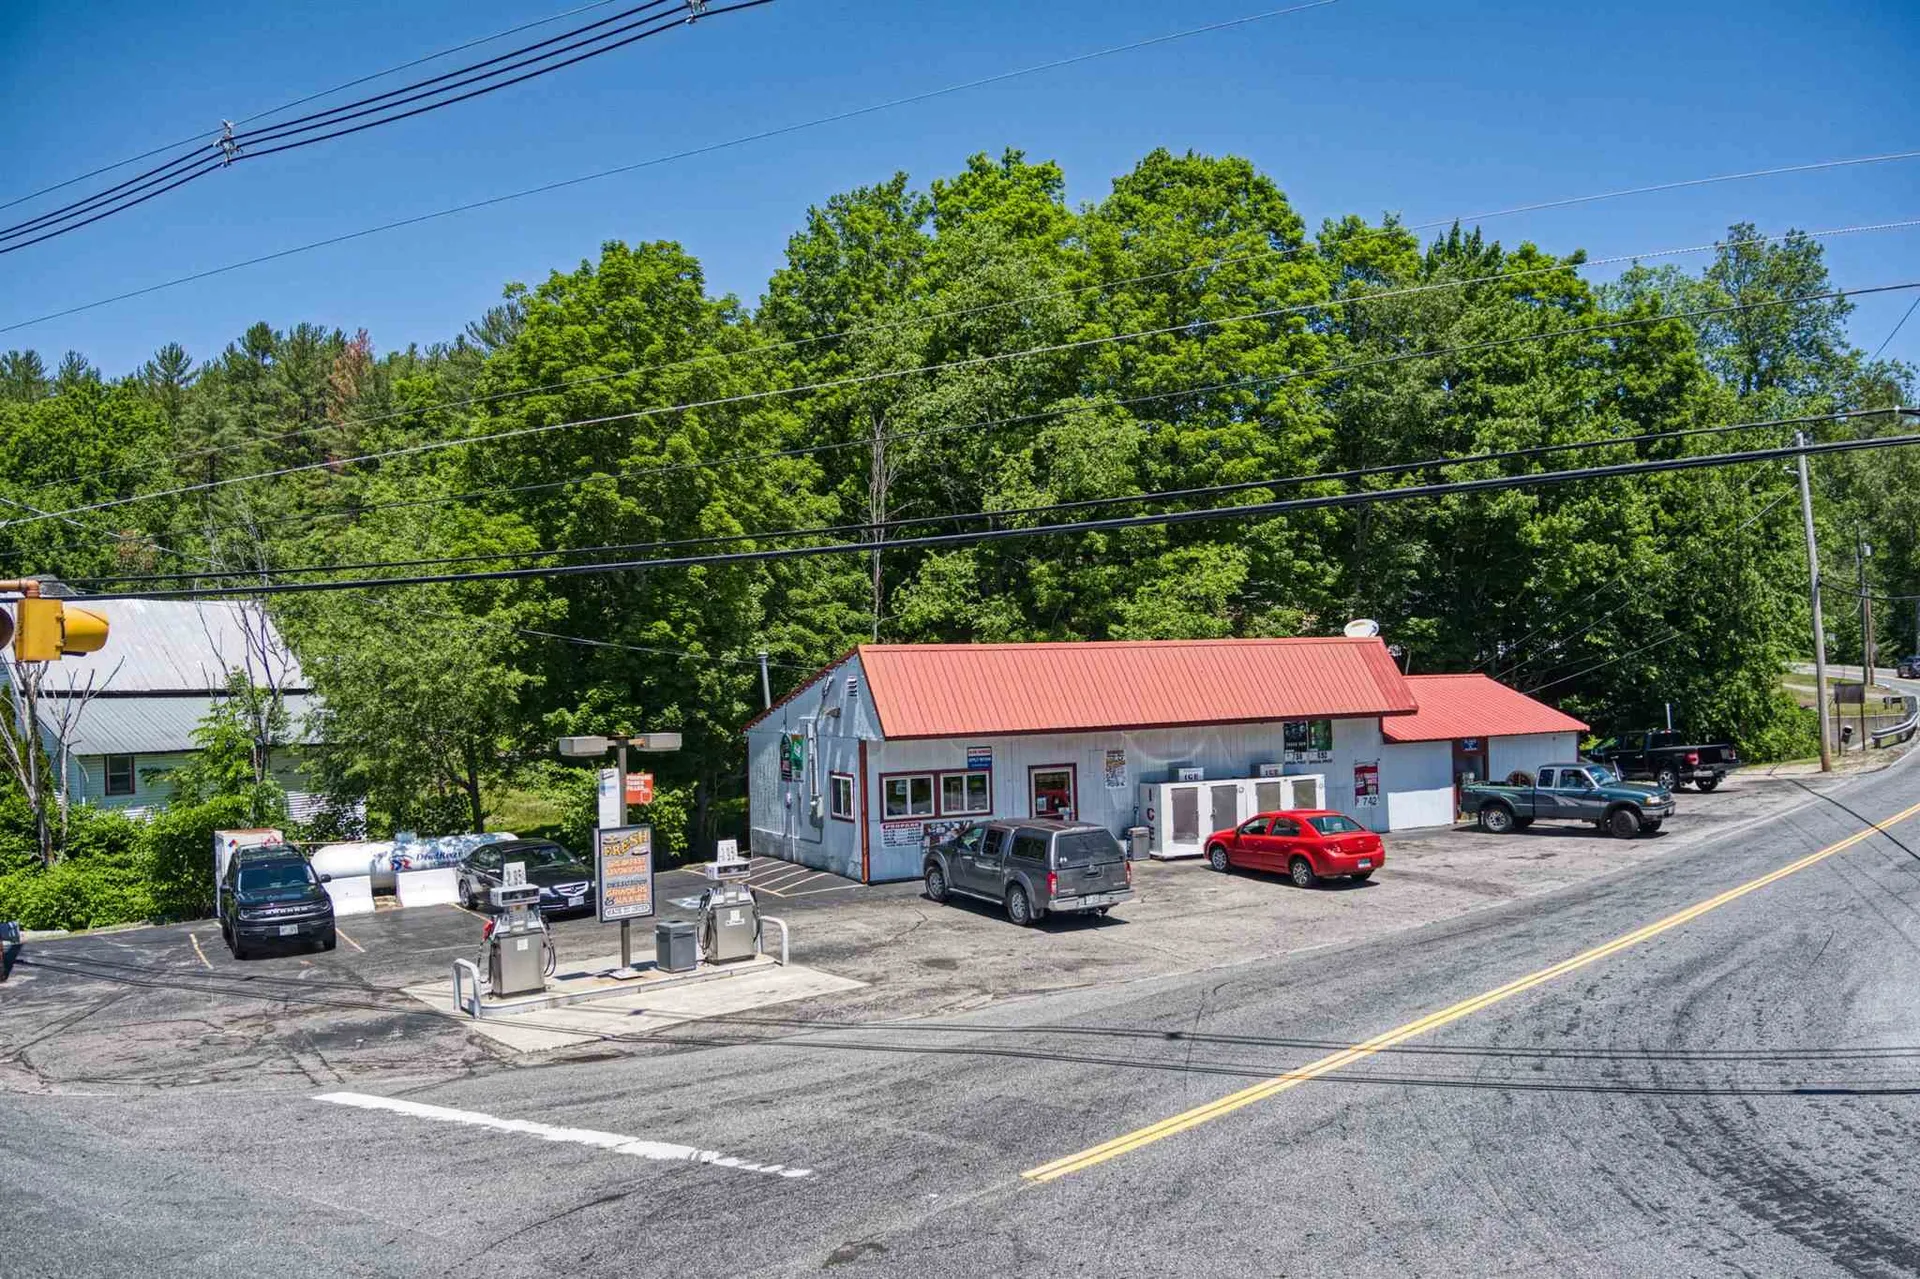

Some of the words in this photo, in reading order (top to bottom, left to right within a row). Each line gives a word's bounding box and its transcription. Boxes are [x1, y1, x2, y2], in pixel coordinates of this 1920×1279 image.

[1184, 773, 1199, 781] ICE
[1363, 796, 1377, 806] 742
[1147, 788, 1155, 841] ICE
[604, 830, 649, 856] FRESH
